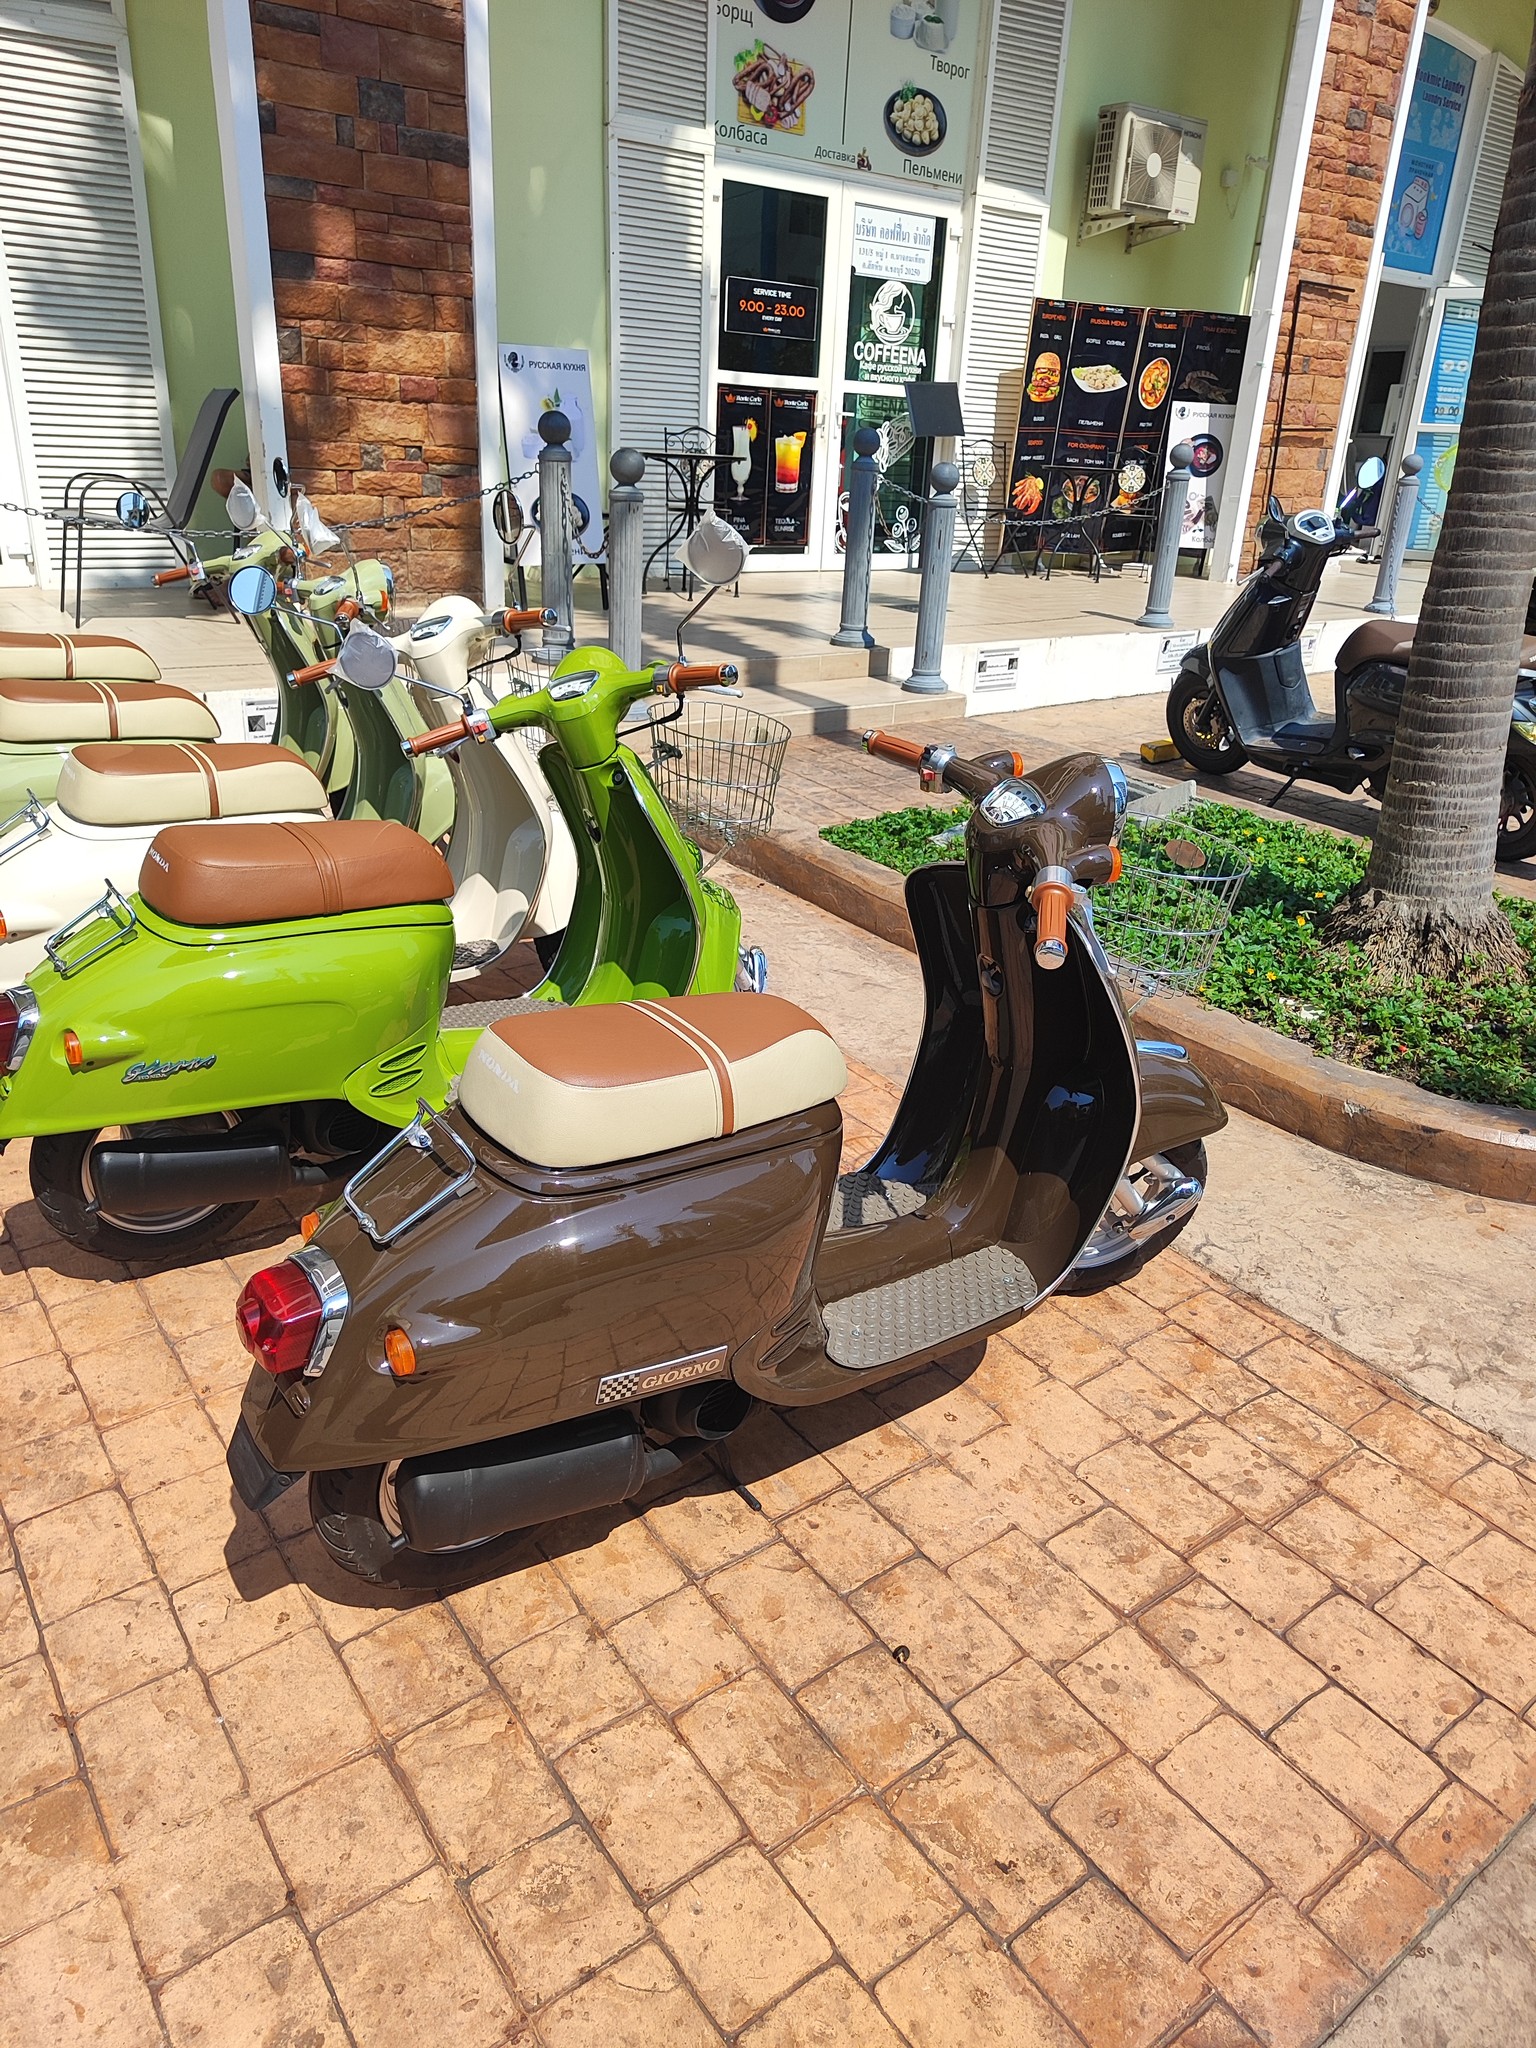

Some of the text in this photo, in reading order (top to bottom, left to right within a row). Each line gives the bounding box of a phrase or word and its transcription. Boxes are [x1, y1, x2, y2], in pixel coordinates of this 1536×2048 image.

[930, 54, 970, 79] Творог
[815, 146, 856, 164] Доставка
[903, 159, 962, 184] Пельмени
[753, 287, 792, 299] SERVICE TIME
[739, 299, 765, 313] 9.00
[774, 303, 805, 318] 23.00
[1110, 319, 1128, 328] MENU
[853, 341, 927, 367] COFFEENA
[528, 360, 586, 371] РУССКАЯ КУХНЯ
[149, 847, 169, 873] HONDA
[641, 1358, 720, 1389] GIORNO
